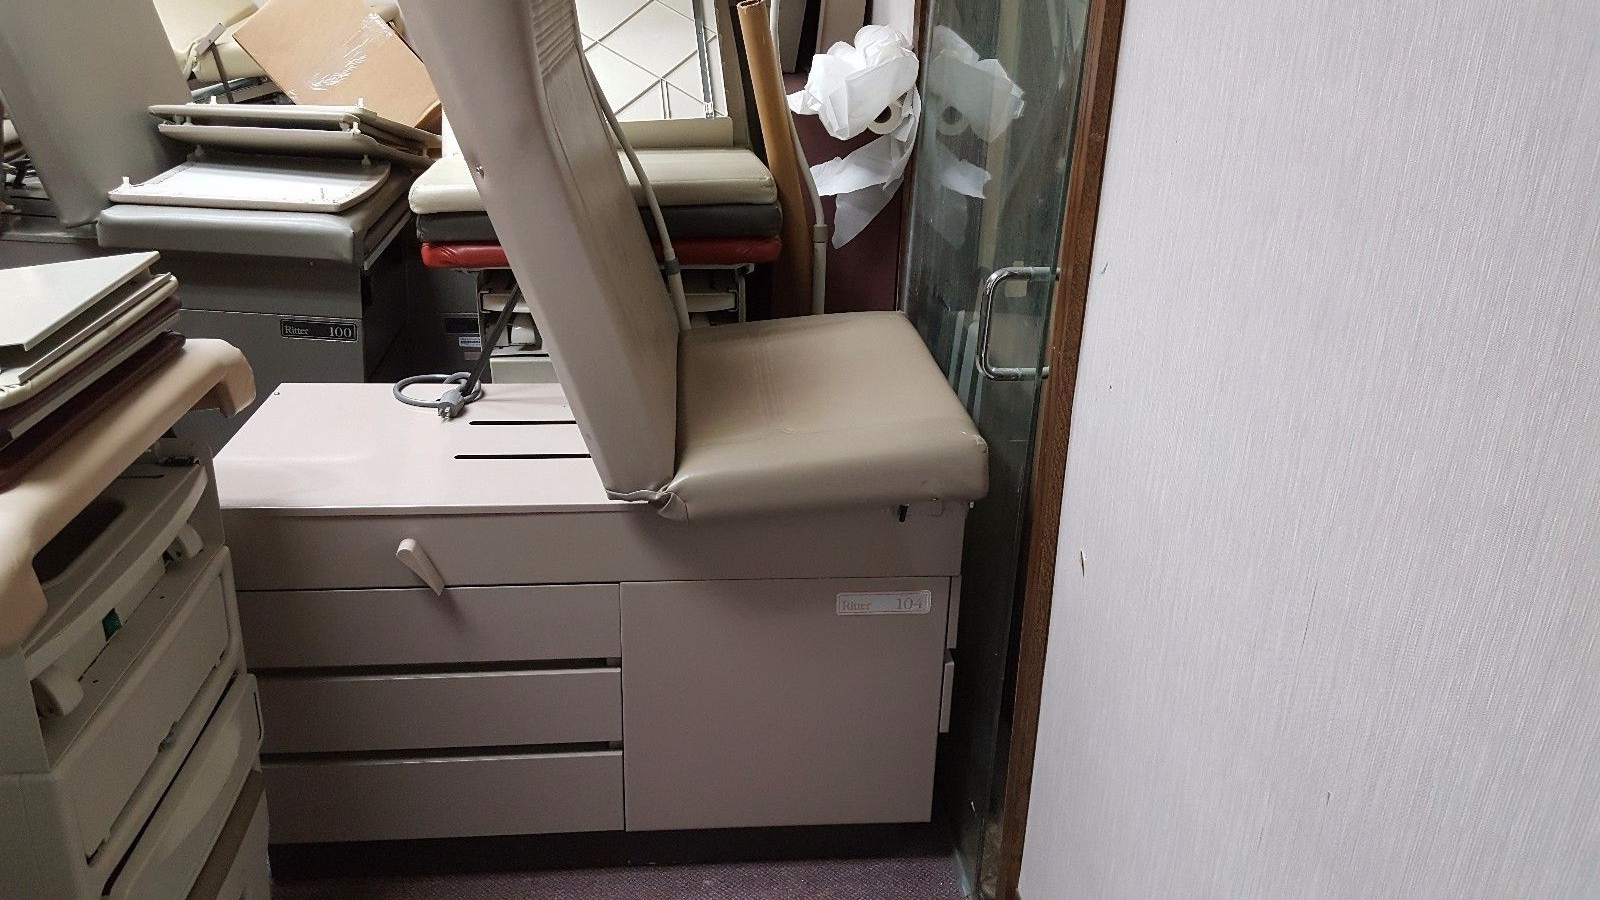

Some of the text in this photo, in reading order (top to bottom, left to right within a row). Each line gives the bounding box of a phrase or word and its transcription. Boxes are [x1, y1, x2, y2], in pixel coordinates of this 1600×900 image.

[284, 324, 352, 338] Ritter 100
[896, 597, 922, 610] 104
